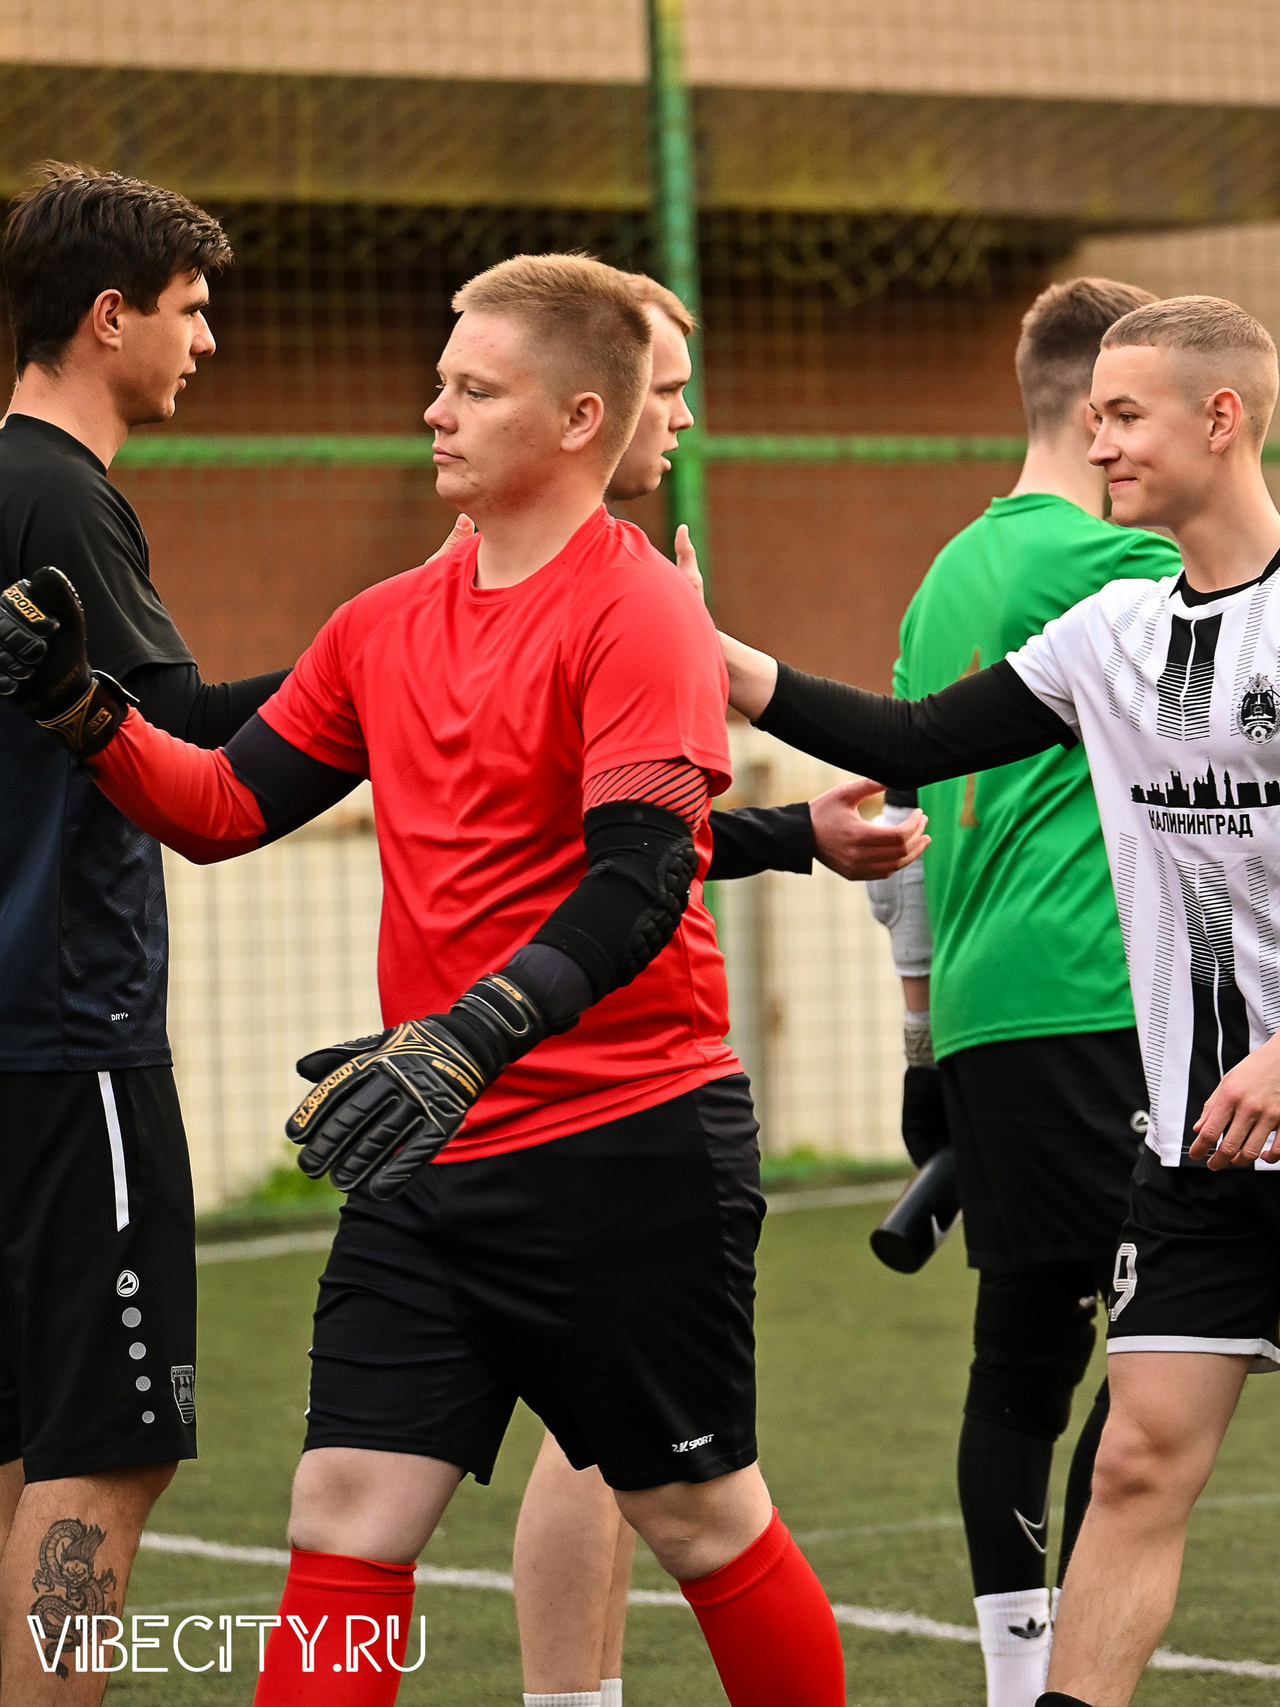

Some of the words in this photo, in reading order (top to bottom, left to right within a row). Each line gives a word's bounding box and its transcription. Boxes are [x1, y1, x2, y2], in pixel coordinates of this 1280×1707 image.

[1148, 809, 1254, 838] КАЛИНИНГРАД
[110, 1012, 129, 1021] DRY+
[1108, 1242, 1138, 1322] 9
